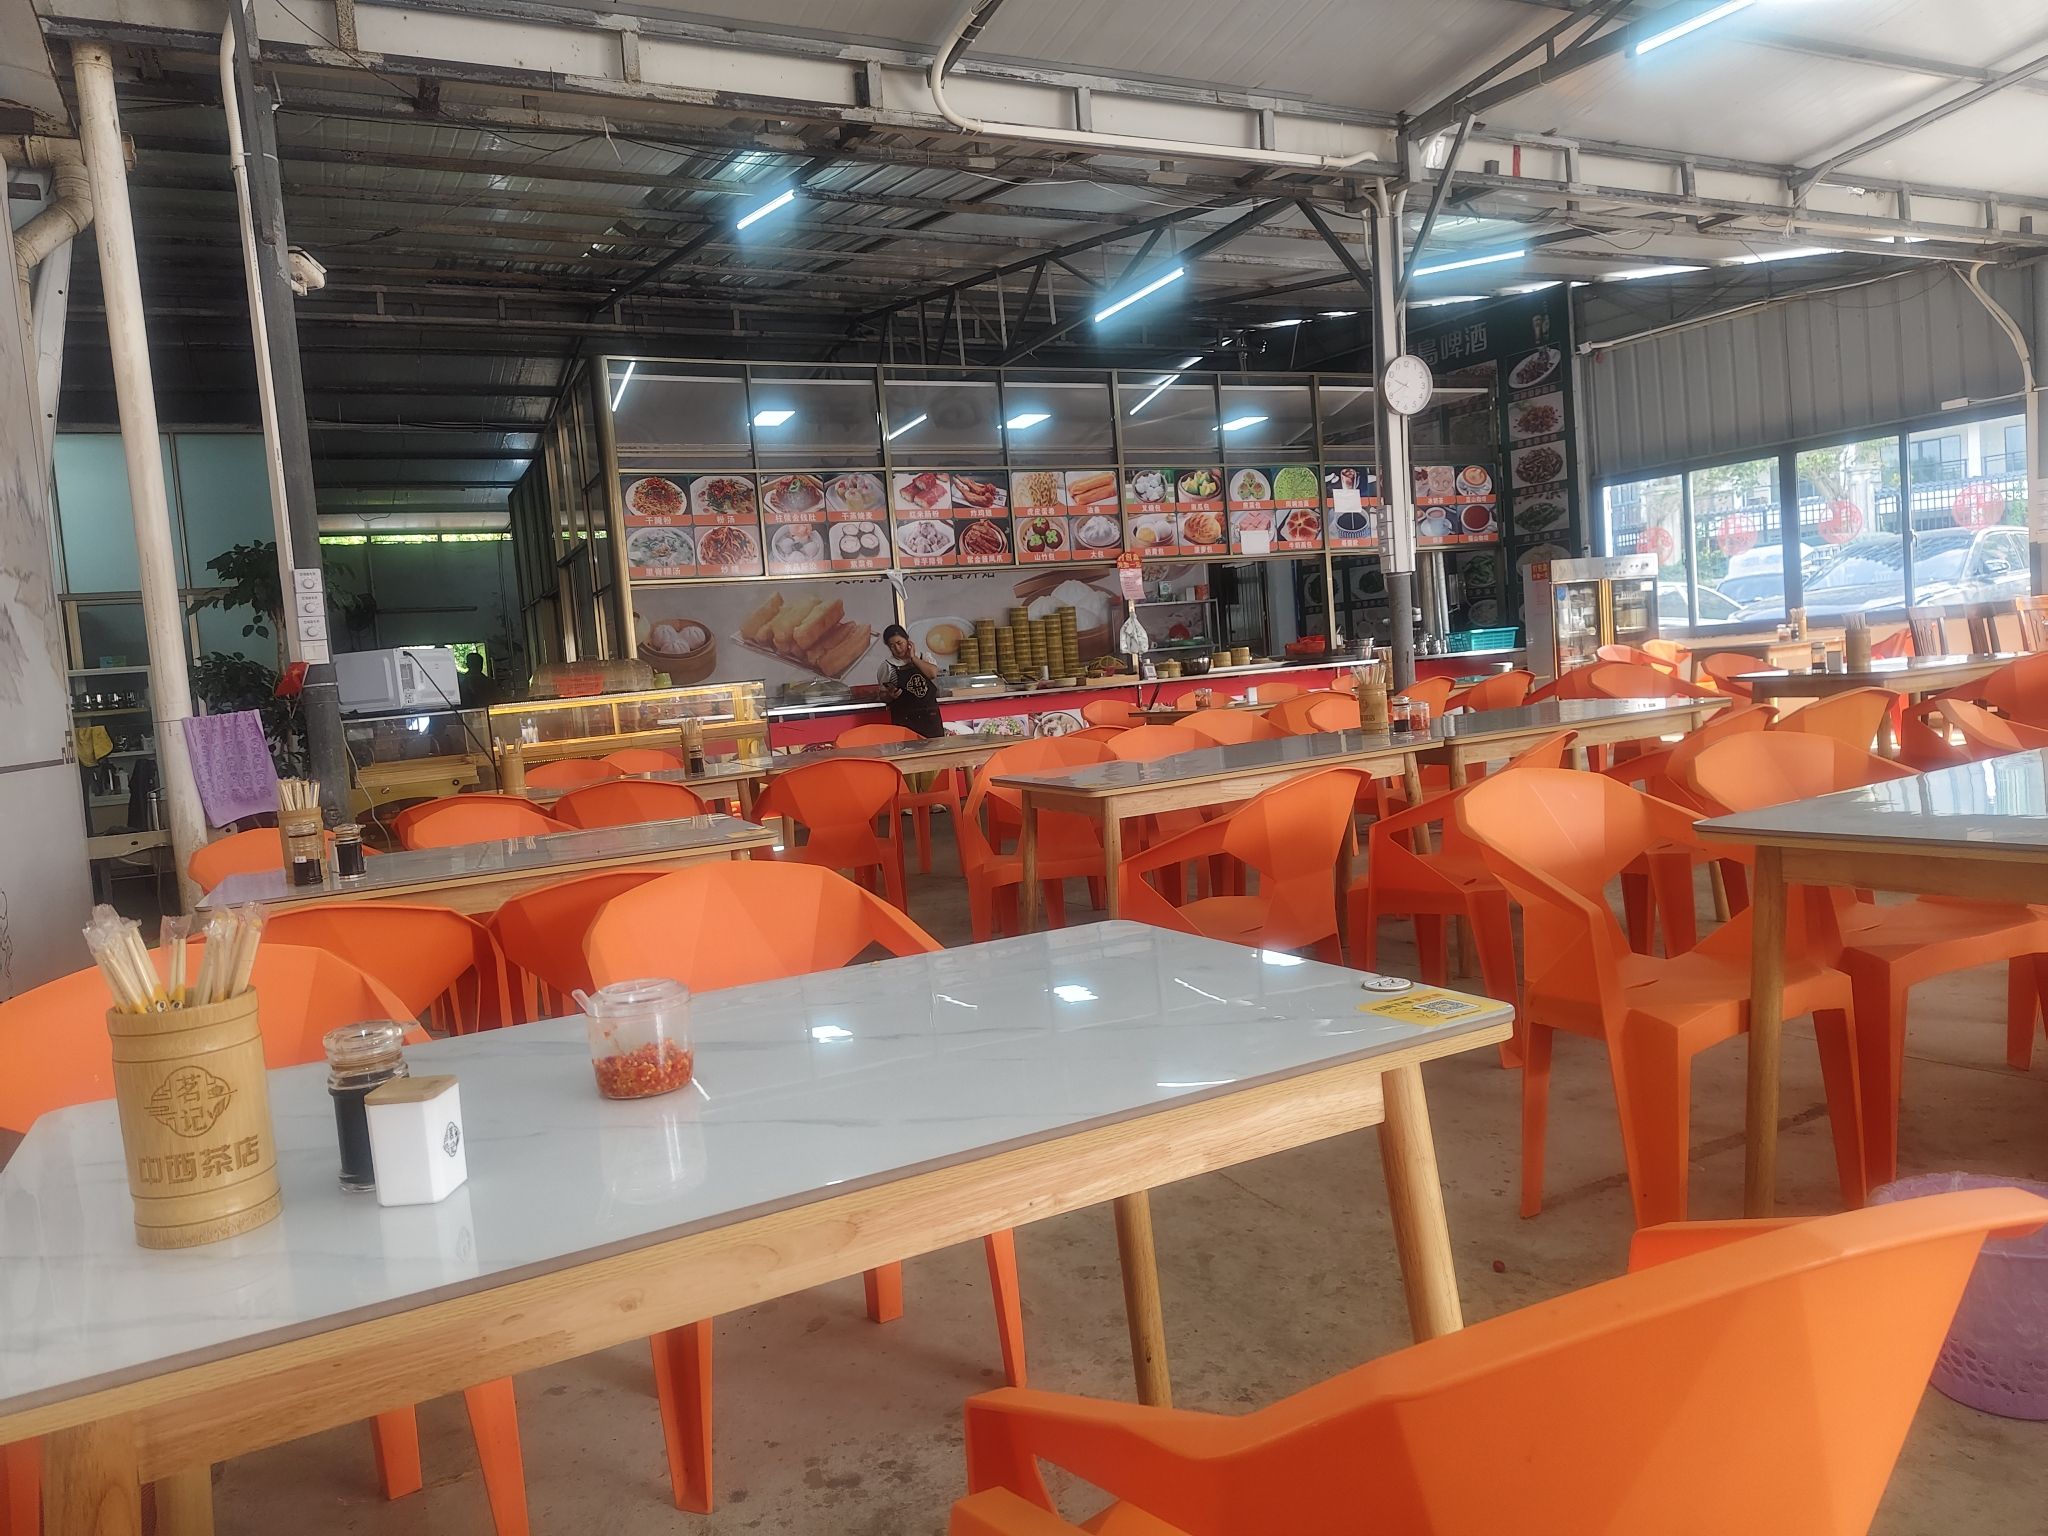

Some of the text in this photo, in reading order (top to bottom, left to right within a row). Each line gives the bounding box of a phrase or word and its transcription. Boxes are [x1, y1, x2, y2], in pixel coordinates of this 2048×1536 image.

[1034, 552, 1055, 561] 山竹包
[1090, 550, 1104, 559] 大包
[176, 1073, 208, 1132] 茗记
[137, 1134, 260, 1186] 中西茶店
